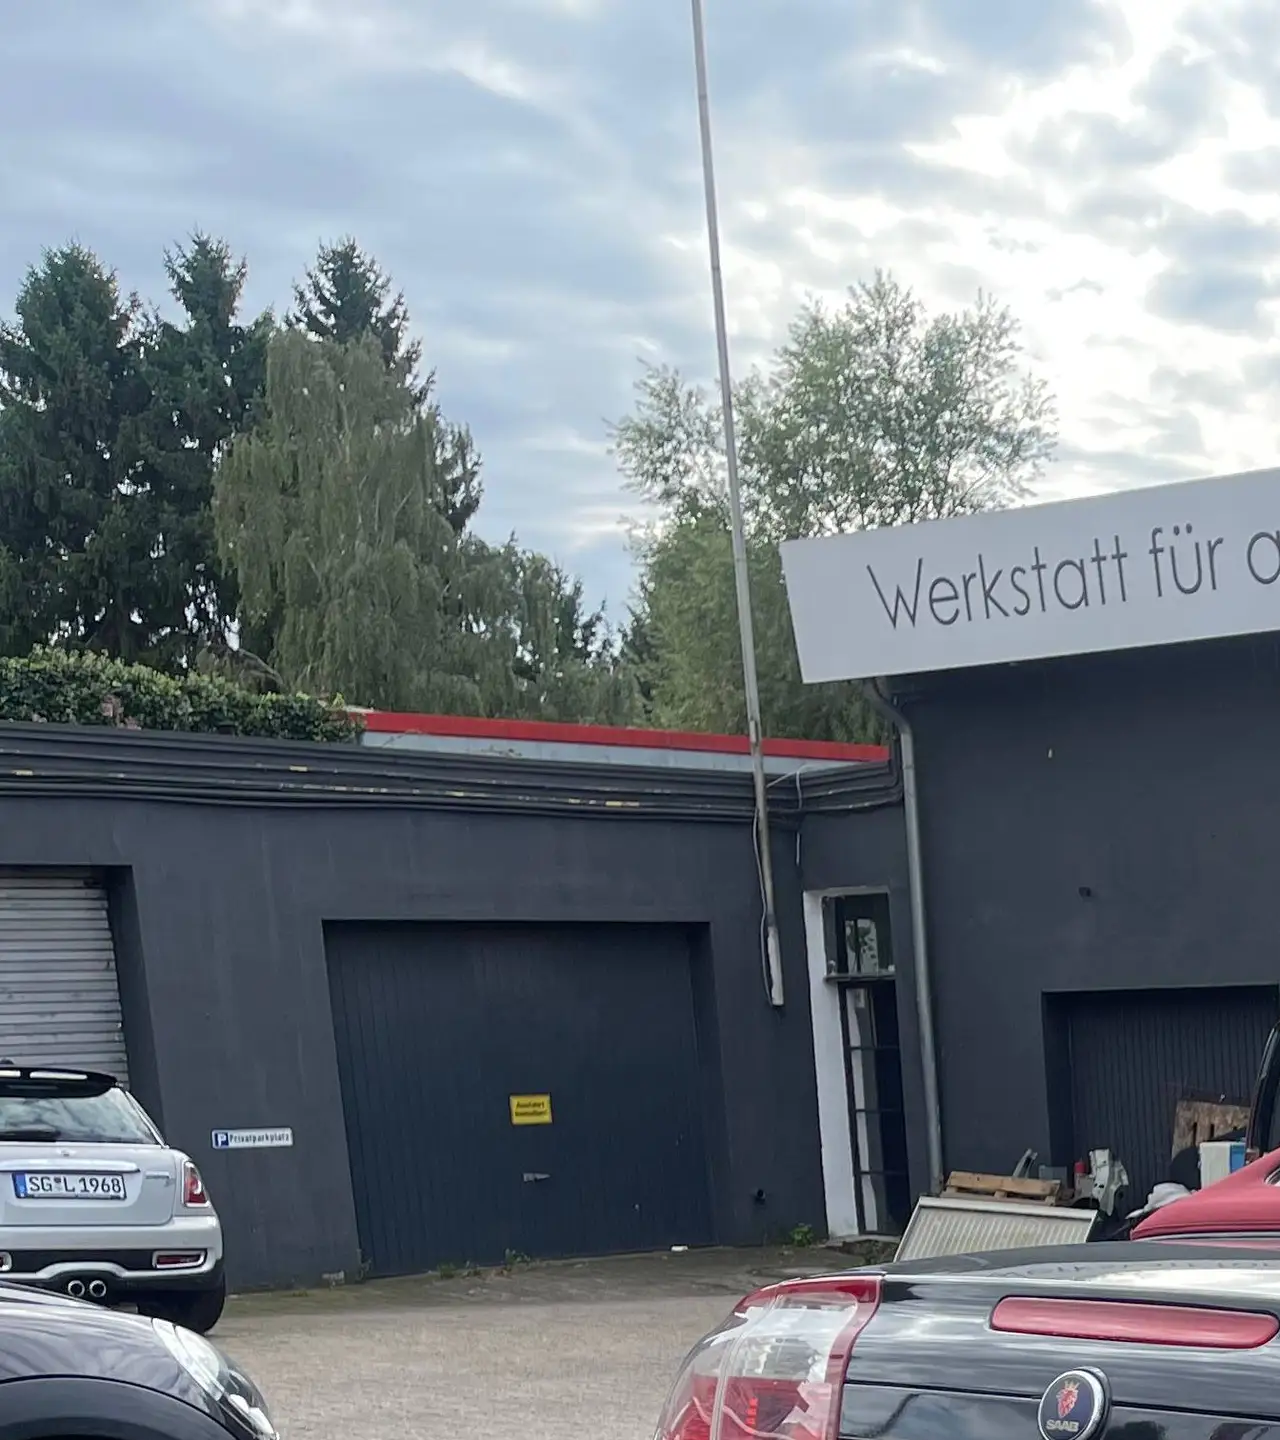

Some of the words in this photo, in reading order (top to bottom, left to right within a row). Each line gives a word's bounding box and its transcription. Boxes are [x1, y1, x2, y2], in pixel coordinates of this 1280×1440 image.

[866, 535, 1128, 629] Werkstatt
[1149, 523, 1224, 597] für
[29, 1175, 53, 1192] SG
[78, 1176, 122, 1194] 1968
[1046, 1419, 1080, 1432] SAAB
